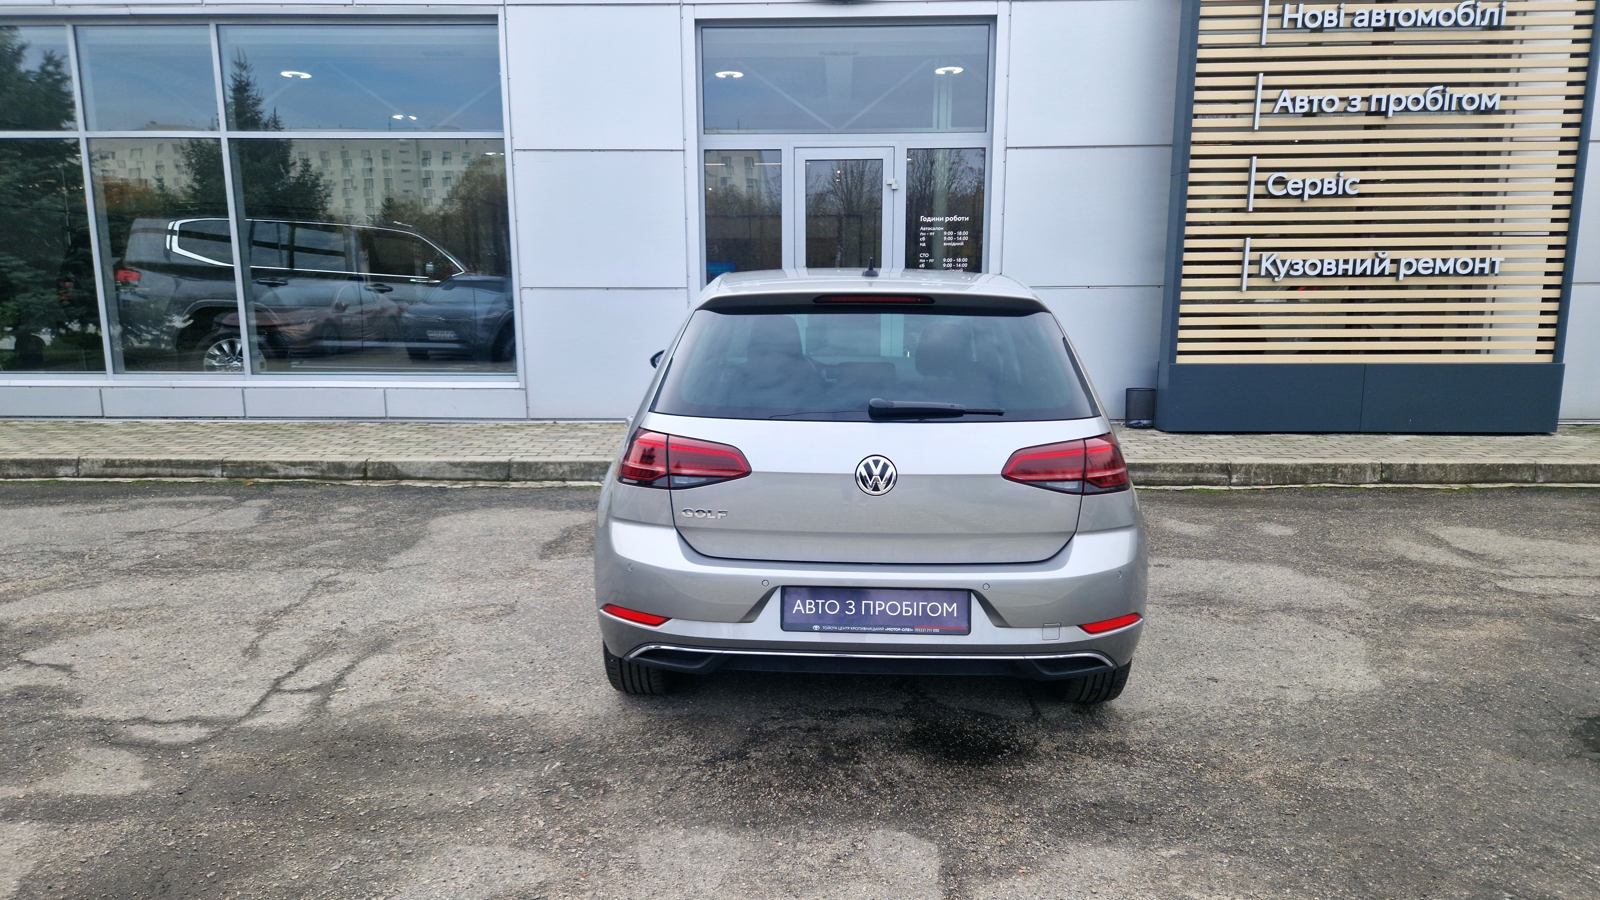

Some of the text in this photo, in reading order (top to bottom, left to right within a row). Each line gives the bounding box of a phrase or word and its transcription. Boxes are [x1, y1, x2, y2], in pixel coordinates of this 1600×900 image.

[1282, 0, 1507, 28] Нові автомобілі
[1272, 85, 1501, 118] Авто з пробігом
[1266, 172, 1360, 201] Сервіс
[945, 214, 969, 223] роботи
[1259, 251, 1505, 281] Кузовний ремонт
[681, 508, 728, 519] GOLF
[792, 599, 840, 615] АВТО
[861, 601, 957, 617] ПРОБІГОМ
